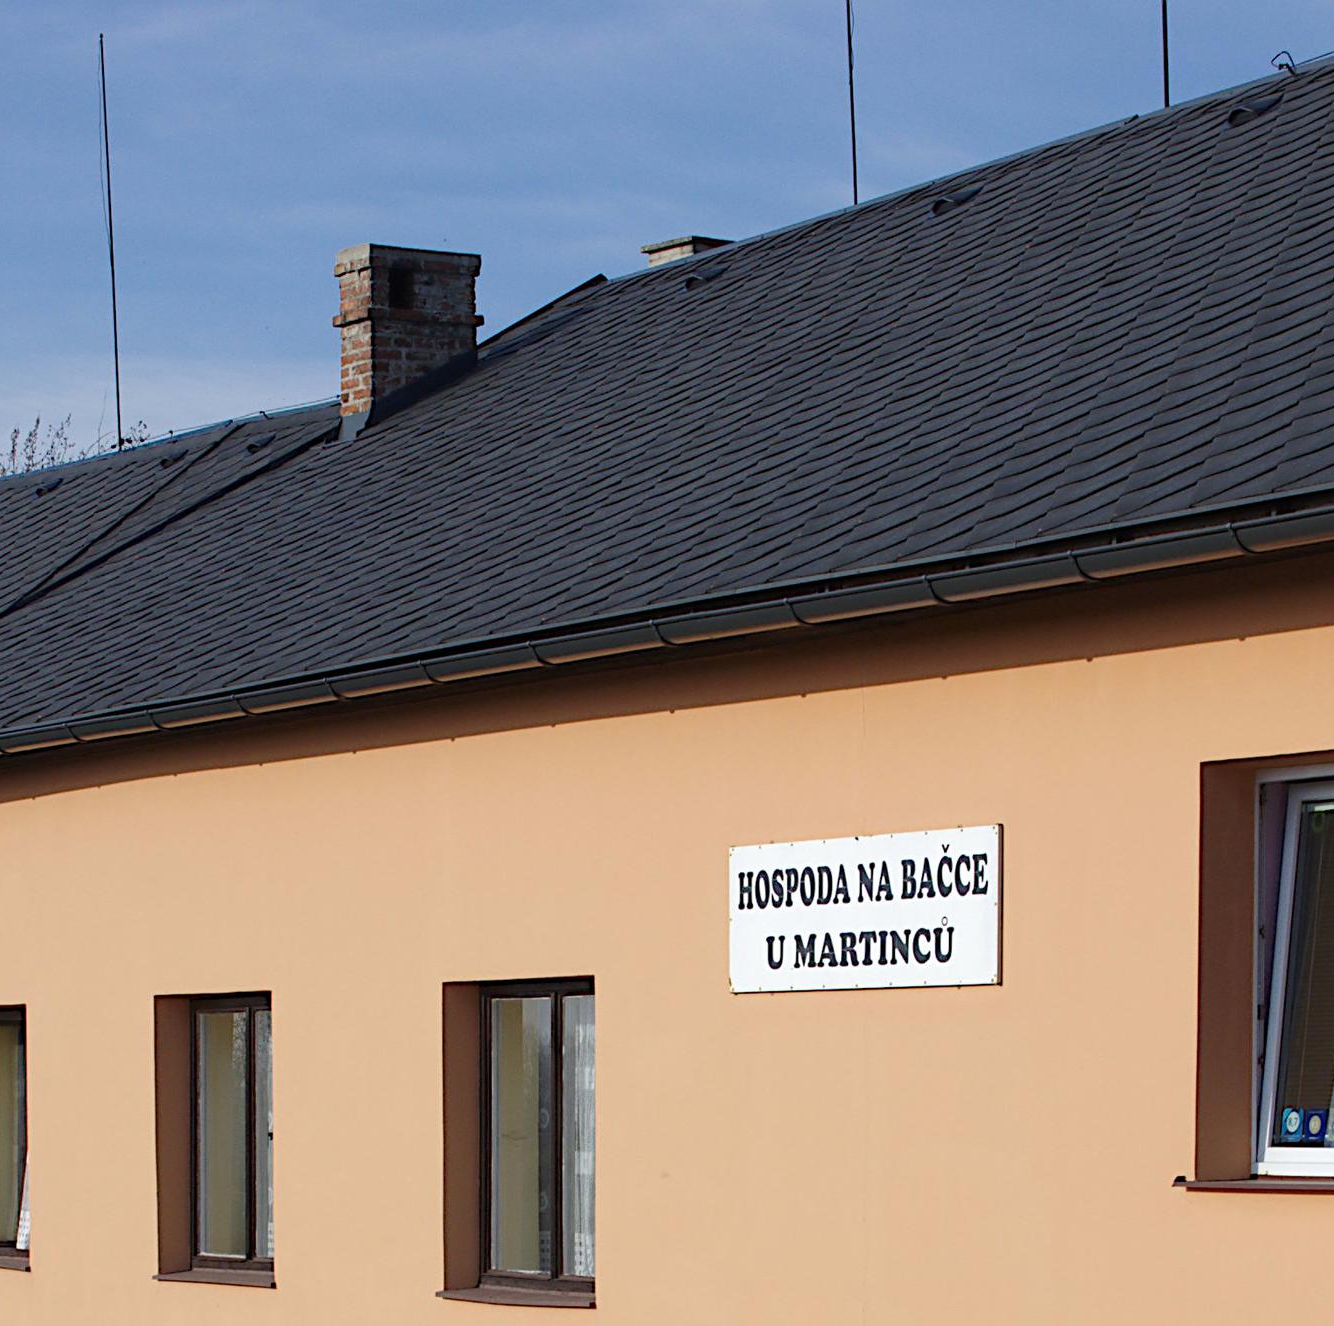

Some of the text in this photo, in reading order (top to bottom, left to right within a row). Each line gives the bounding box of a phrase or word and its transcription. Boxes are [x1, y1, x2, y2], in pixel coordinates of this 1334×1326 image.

[737, 843, 989, 910] HOSPODA NA BAČCE
[766, 916, 955, 970] U MARTINCŮ
